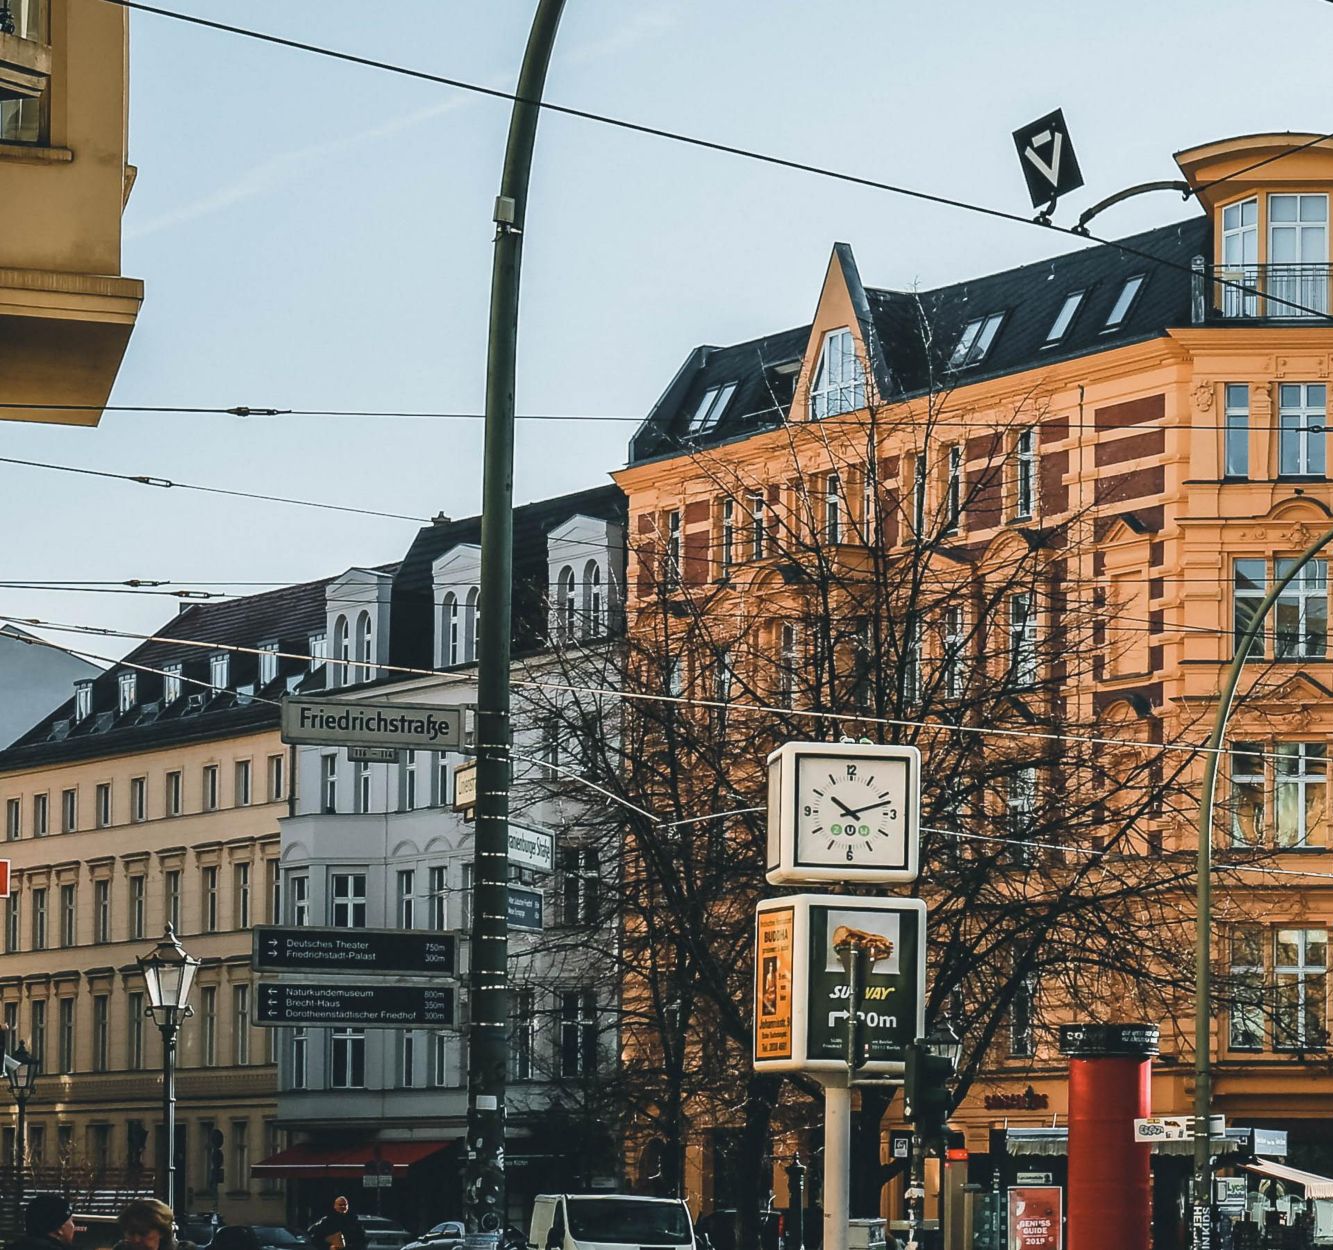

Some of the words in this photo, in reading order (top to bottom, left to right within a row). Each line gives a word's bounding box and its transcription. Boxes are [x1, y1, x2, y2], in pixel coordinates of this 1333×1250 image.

[300, 707, 450, 740] Friedrichstraße
[846, 765, 857, 776] 12
[804, 805, 811, 816] 9
[890, 809, 897, 820] 3
[846, 851, 853, 861] 6
[286, 939, 333, 948] Deutsches
[336, 940, 369, 949] Theater
[425, 943, 446, 951] 750m
[286, 950, 376, 961] Friedrichstadt-Palast
[425, 954, 446, 962] 300m
[286, 988, 374, 997] Naturkundemuseum
[286, 999, 341, 1007] Brecht-Haus
